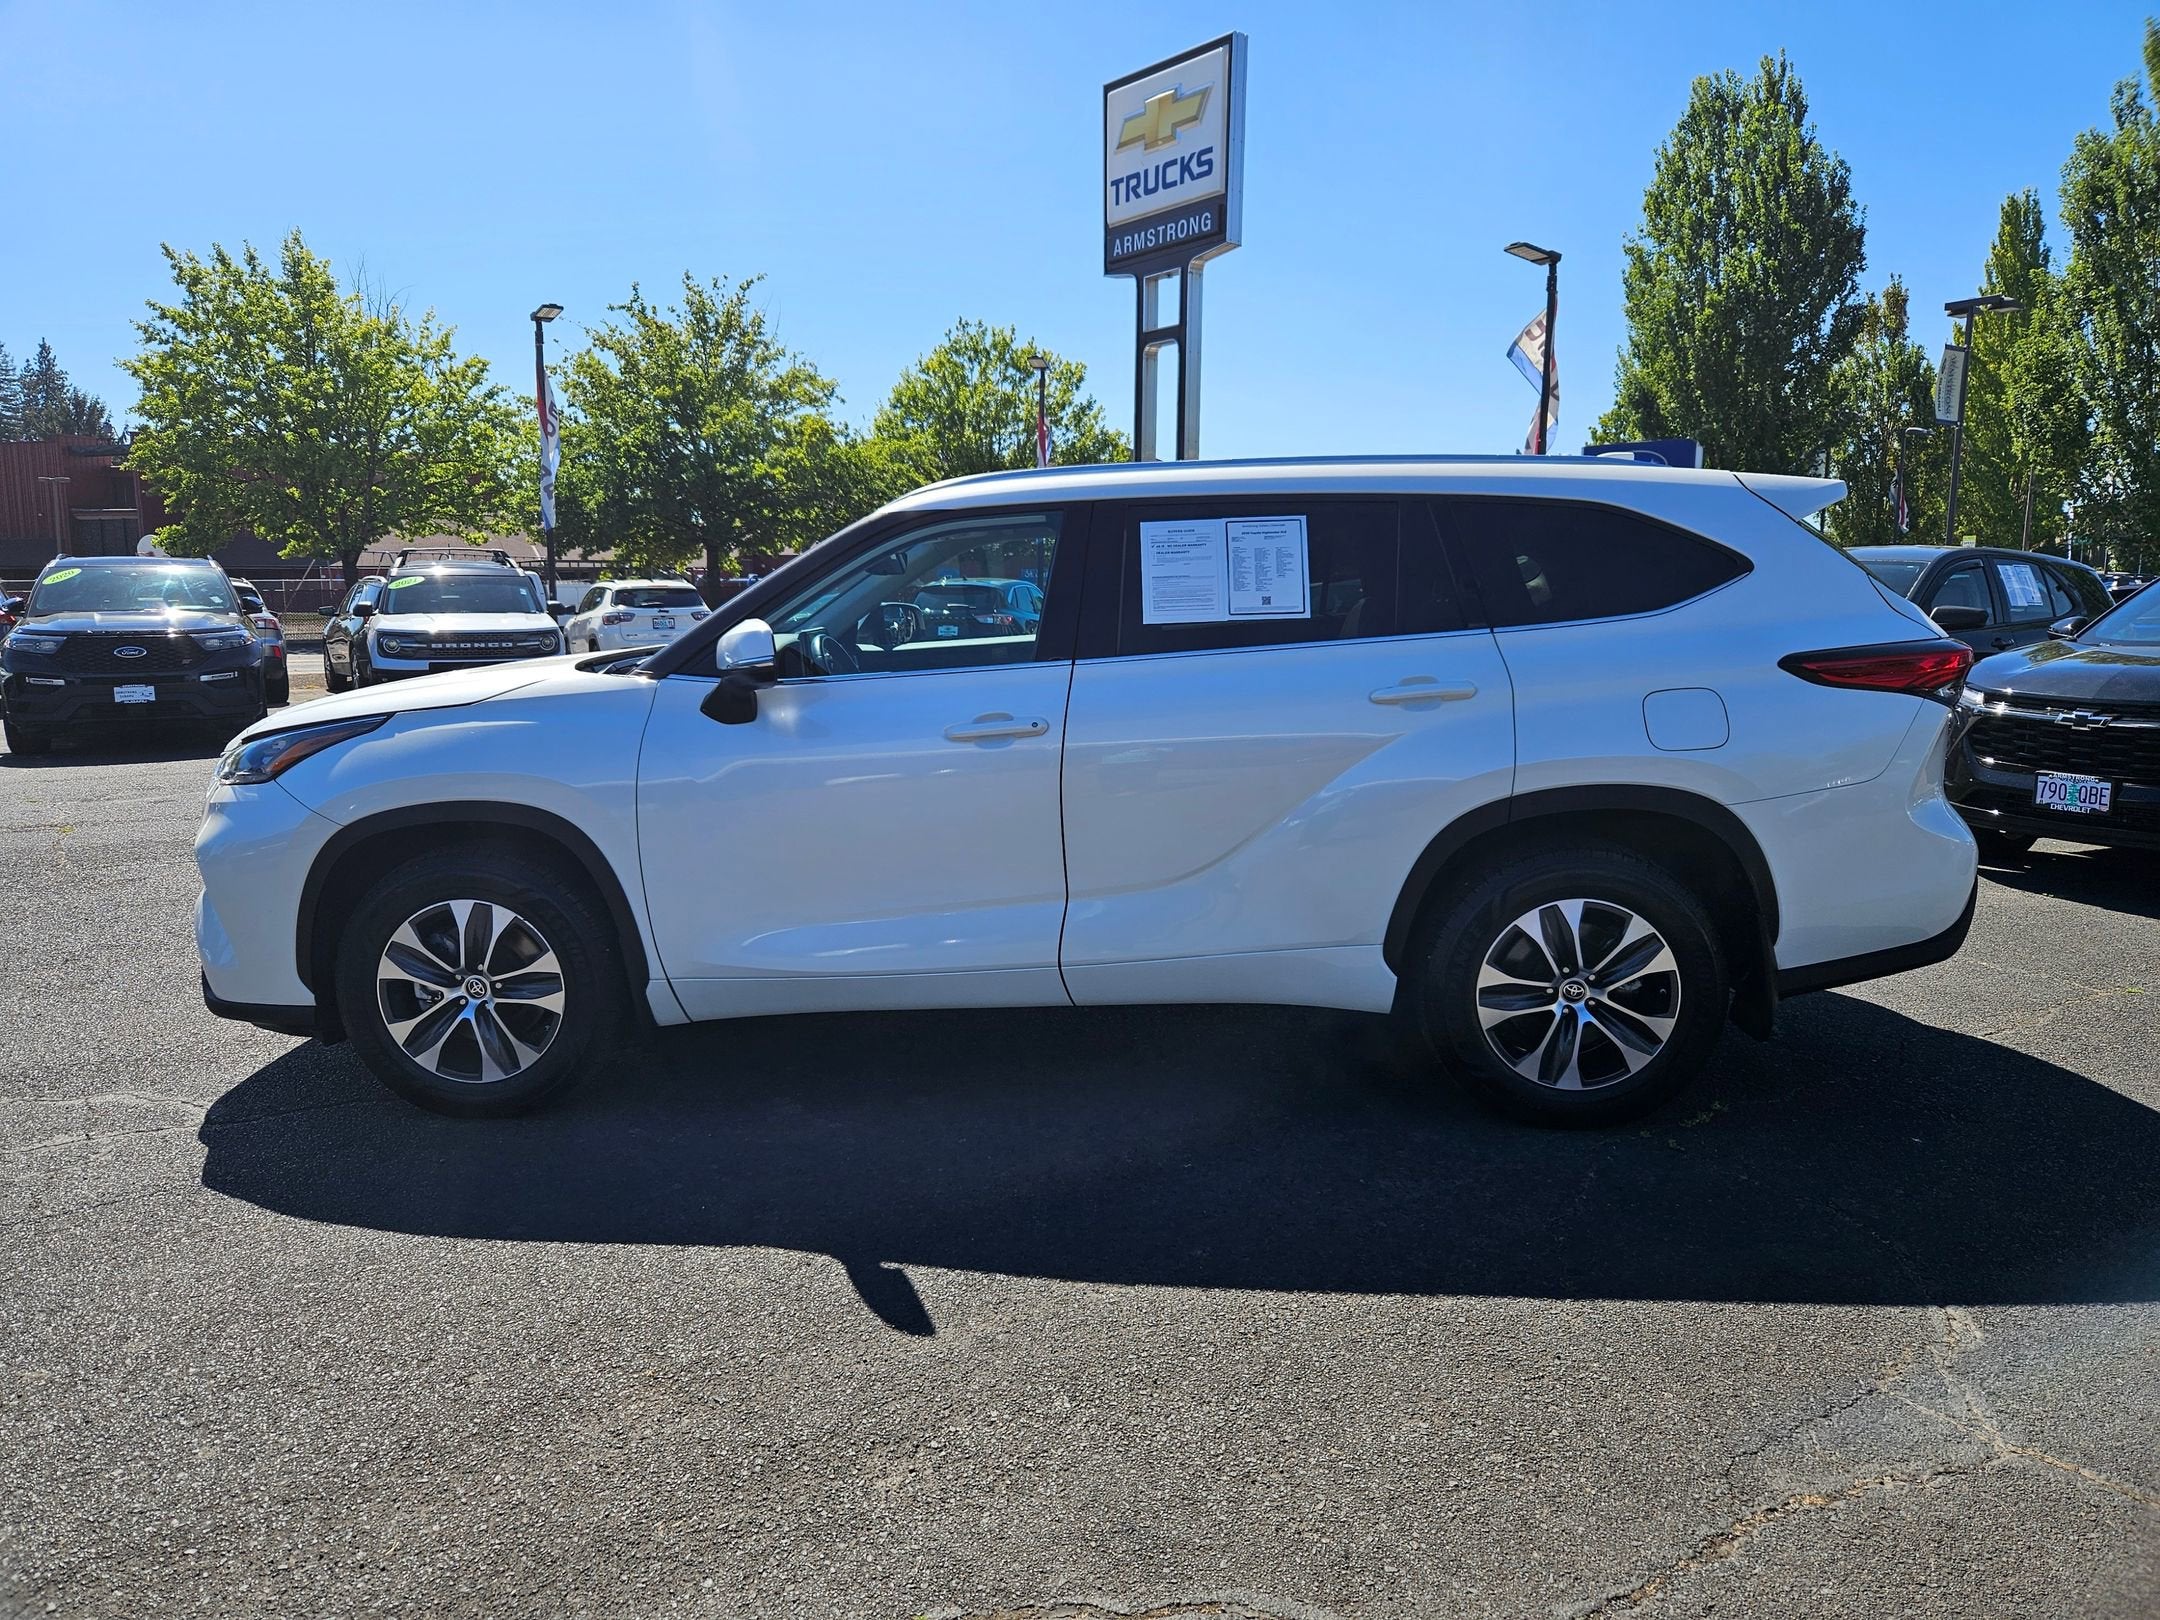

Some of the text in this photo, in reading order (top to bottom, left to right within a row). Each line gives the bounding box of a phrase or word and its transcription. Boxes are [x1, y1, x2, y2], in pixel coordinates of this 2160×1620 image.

[1110, 146, 1213, 206] TRUCKS
[1113, 213, 1211, 257] ARMSTRONG
[2038, 780, 2110, 807] 790 QBE
[2050, 803, 2092, 814] CHEVROLET
